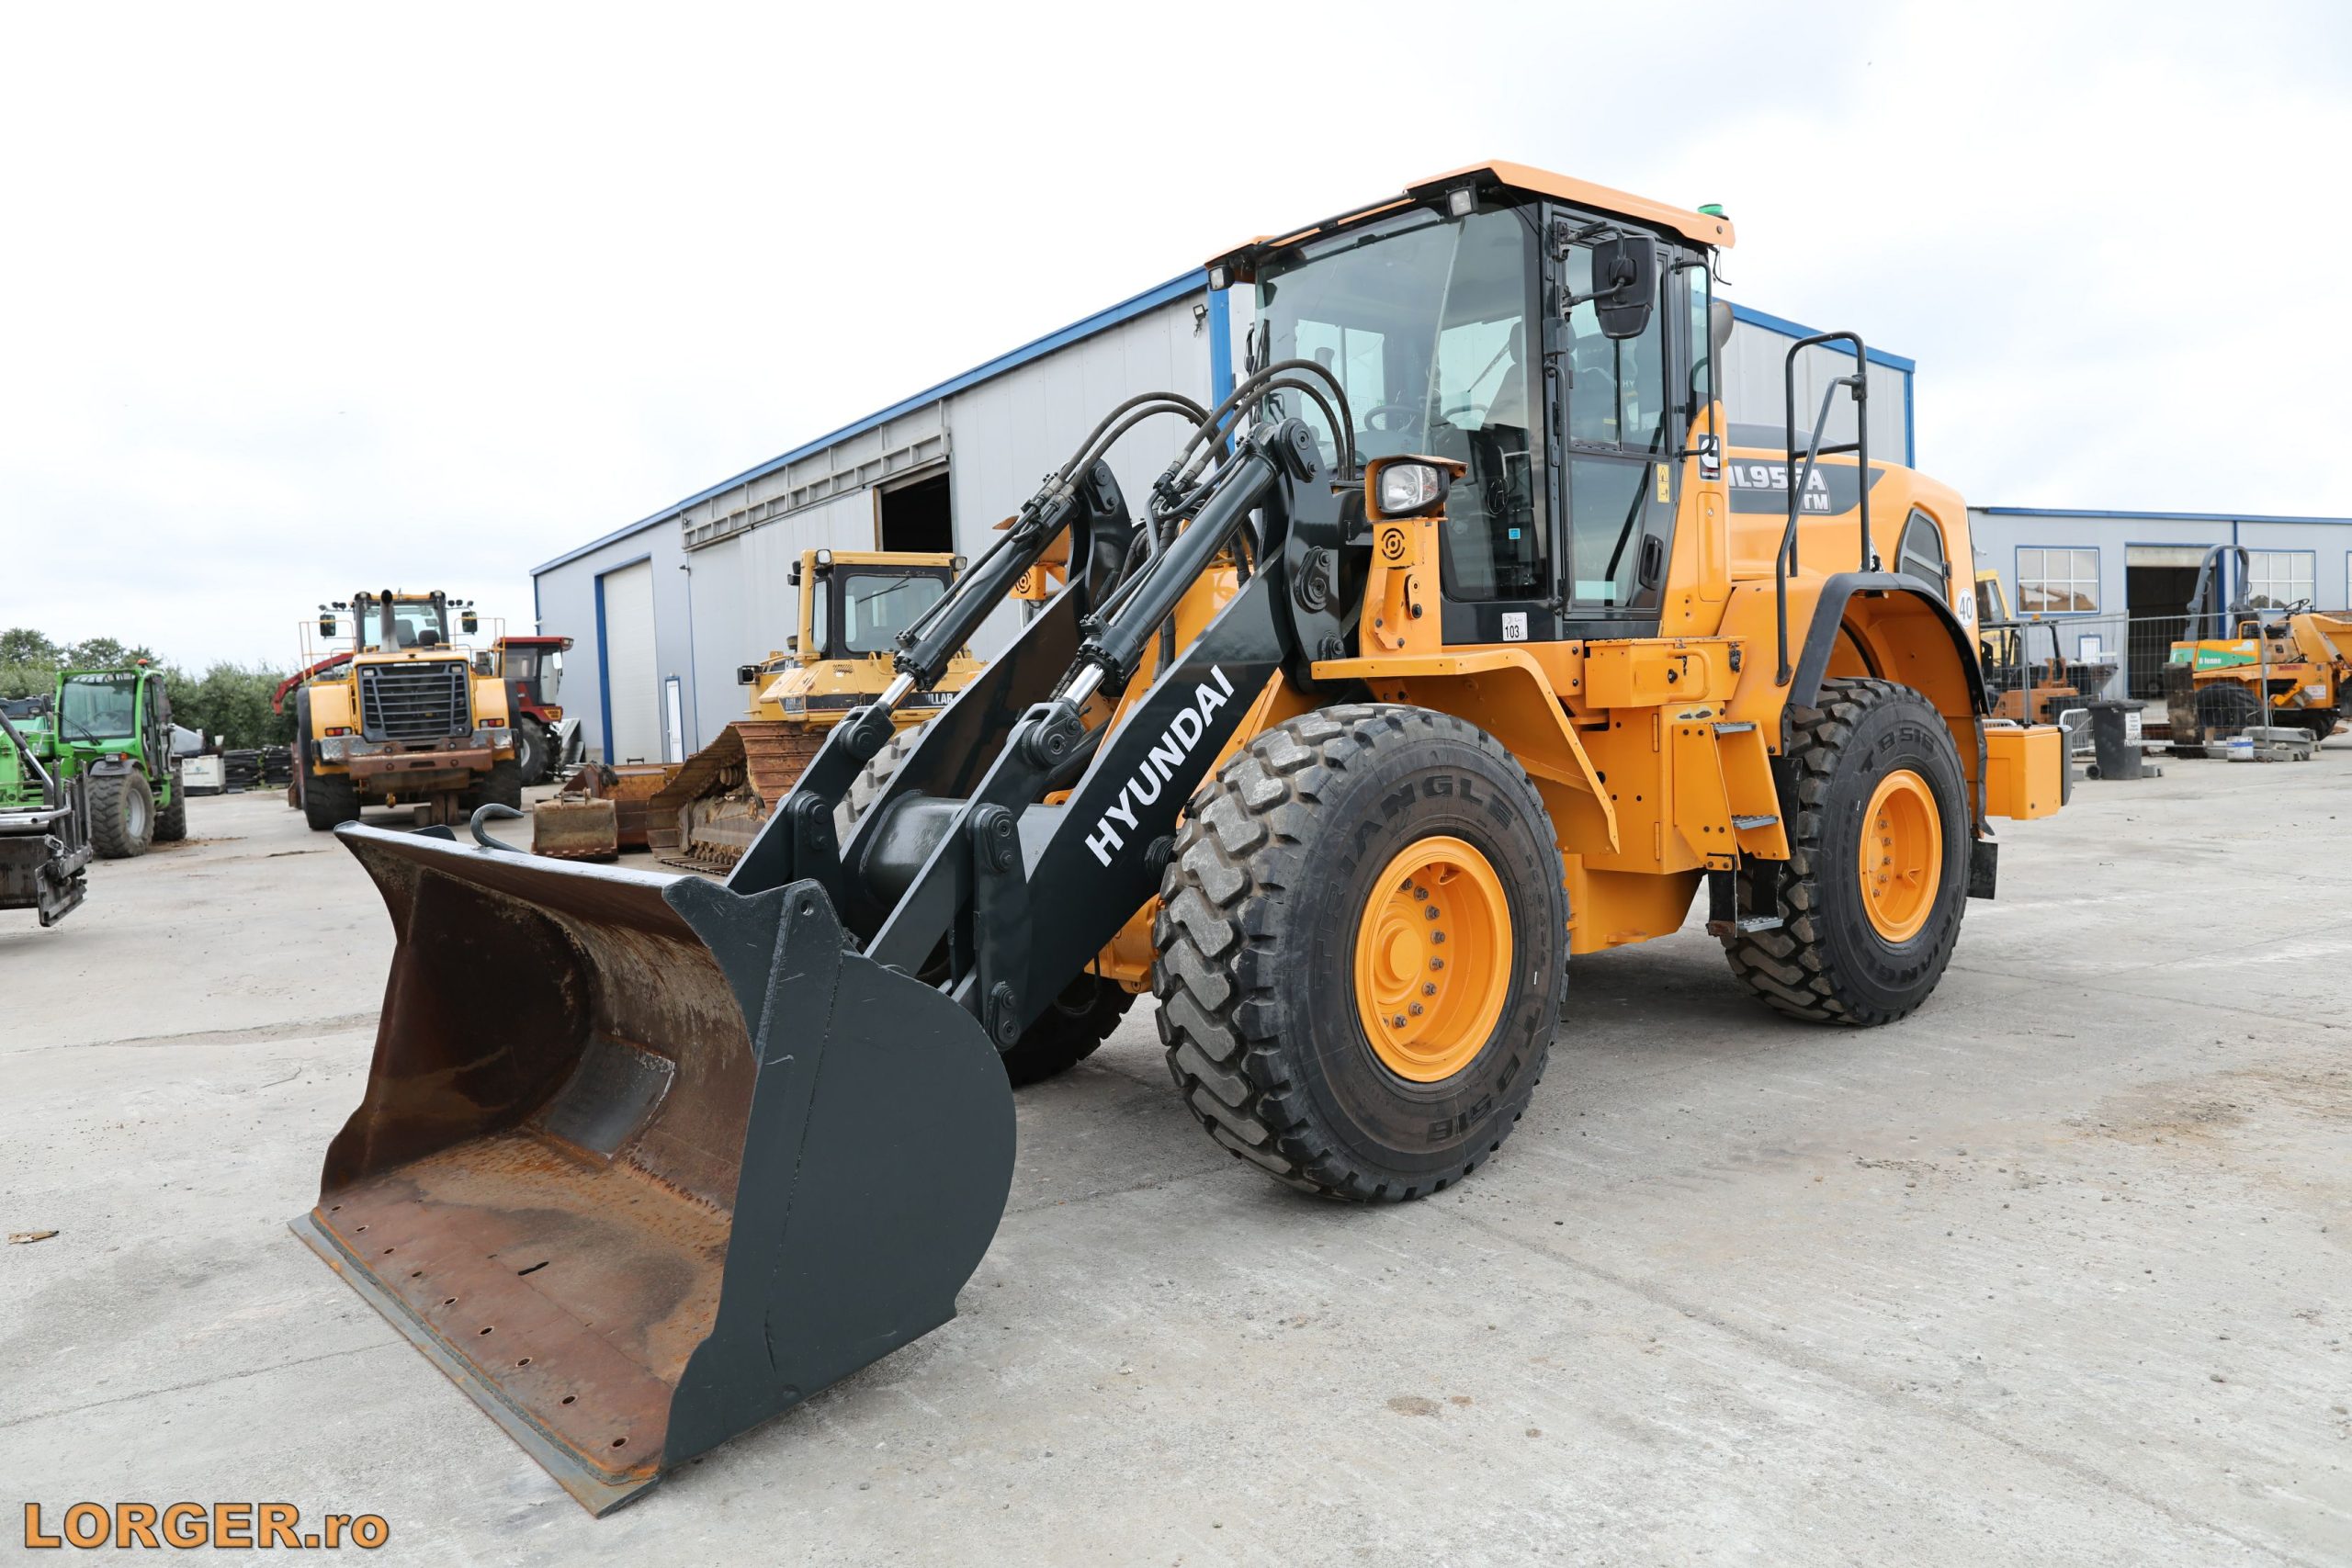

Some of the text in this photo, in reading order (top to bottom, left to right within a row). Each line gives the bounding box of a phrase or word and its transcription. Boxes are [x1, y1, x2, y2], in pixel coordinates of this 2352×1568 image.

[1505, 625, 1521, 638] 103
[1959, 596, 1973, 621] 40
[1084, 664, 1235, 868] HYUNDAI
[1314, 774, 1515, 990] TRIANGLE
